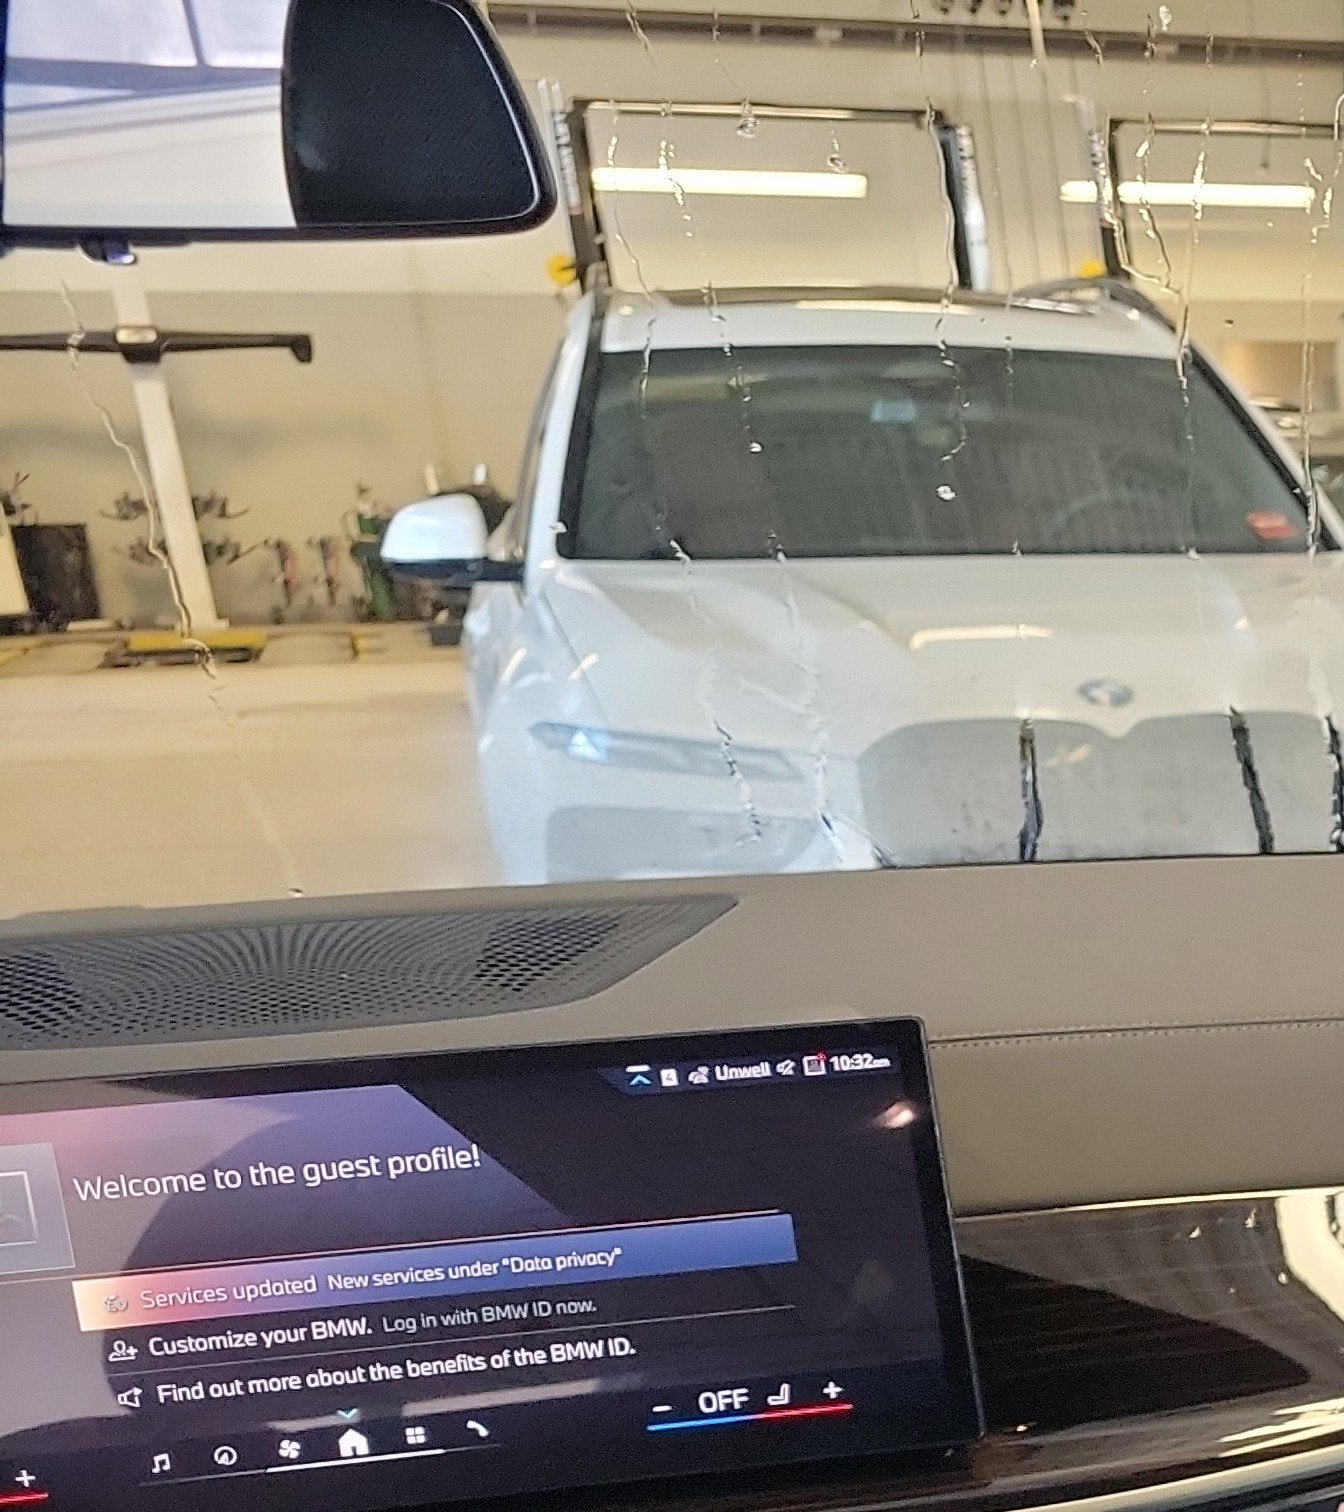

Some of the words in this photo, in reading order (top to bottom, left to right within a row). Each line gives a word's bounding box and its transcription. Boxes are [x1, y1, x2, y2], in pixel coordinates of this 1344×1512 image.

[714, 1062, 772, 1081] Unwell
[73, 1171, 206, 1201] Welcome
[214, 1168, 242, 1189] to
[249, 1161, 295, 1186] the
[303, 1155, 382, 1187] guest
[388, 1144, 481, 1179] profile!
[140, 1286, 228, 1309] Services
[233, 1276, 317, 1301] updated
[327, 1273, 368, 1290] New
[372, 1267, 445, 1286] services
[448, 1260, 500, 1279] under
[149, 1330, 258, 1356] Customize
[262, 1327, 308, 1349] your
[311, 1317, 373, 1340] BMW.
[382, 1315, 416, 1333] Log
[421, 1312, 437, 1328] in
[441, 1307, 479, 1326] with
[481, 1301, 528, 1322] BMW
[532, 1301, 552, 1317] ID
[556, 1300, 597, 1315] now.
[157, 1380, 204, 1404] Find
[209, 1380, 244, 1399] out
[248, 1373, 302, 1394] more
[306, 1368, 366, 1388] about
[369, 1362, 402, 1382] the
[407, 1353, 487, 1378] benefits
[490, 1349, 512, 1369] of
[513, 1347, 547, 1367] the
[550, 1340, 604, 1362] BMW
[608, 1337, 637, 1357] ID.
[698, 1388, 749, 1413] OFF
